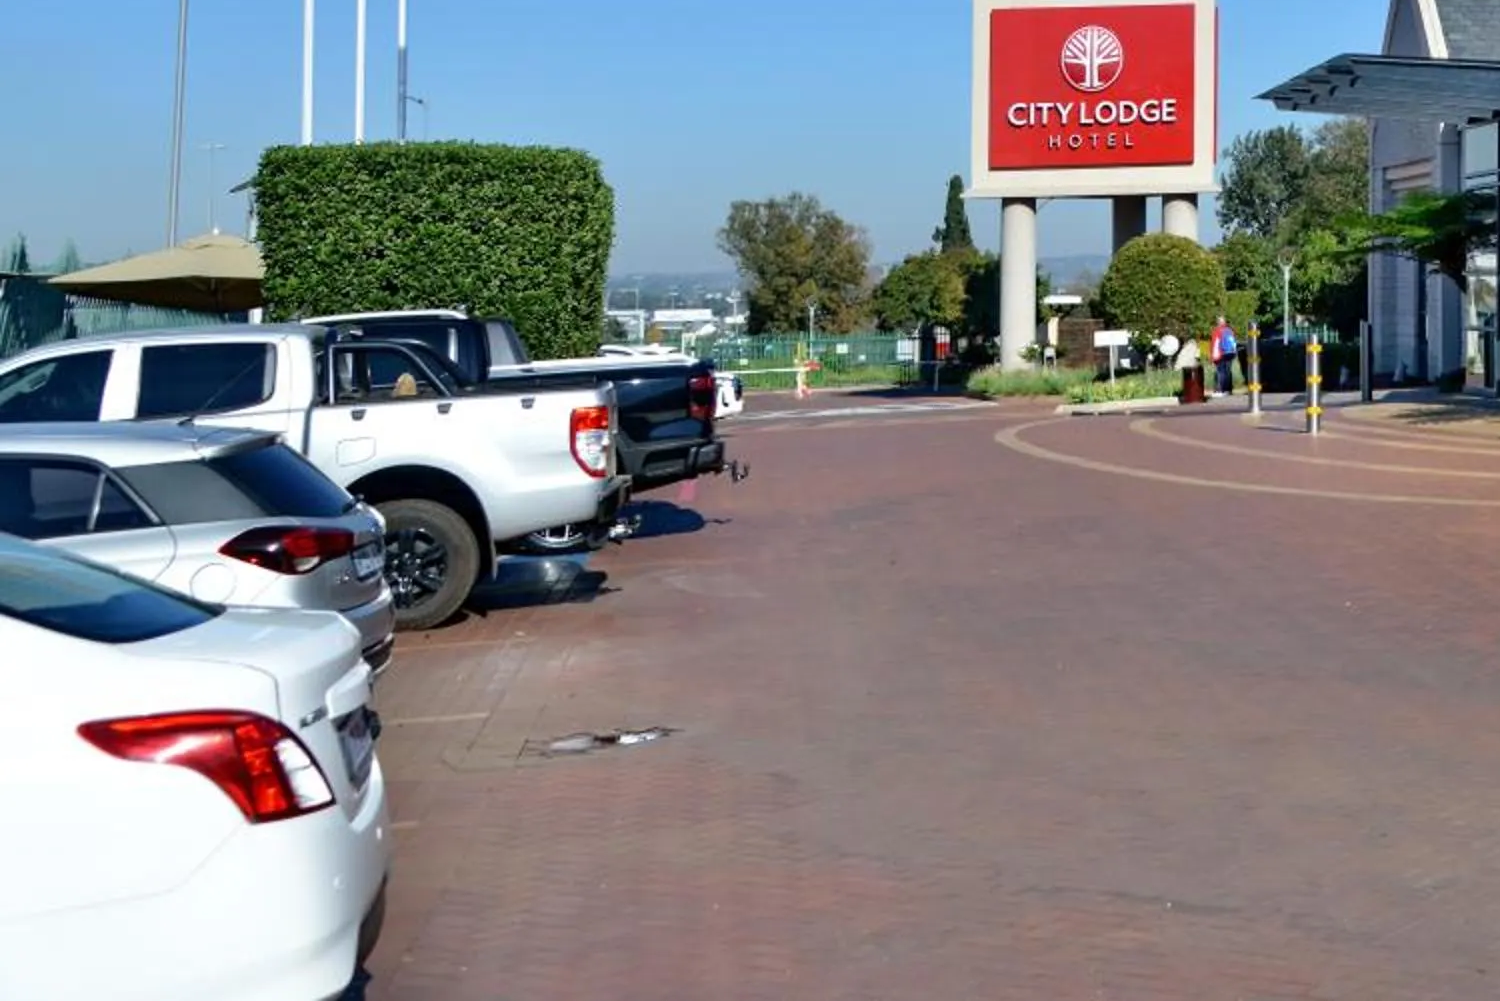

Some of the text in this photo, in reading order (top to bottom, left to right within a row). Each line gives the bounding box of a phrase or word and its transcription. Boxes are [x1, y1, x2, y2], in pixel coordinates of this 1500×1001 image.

[1008, 99, 1177, 126] CITY LODGE
[1049, 131, 1134, 149] HOTEL
